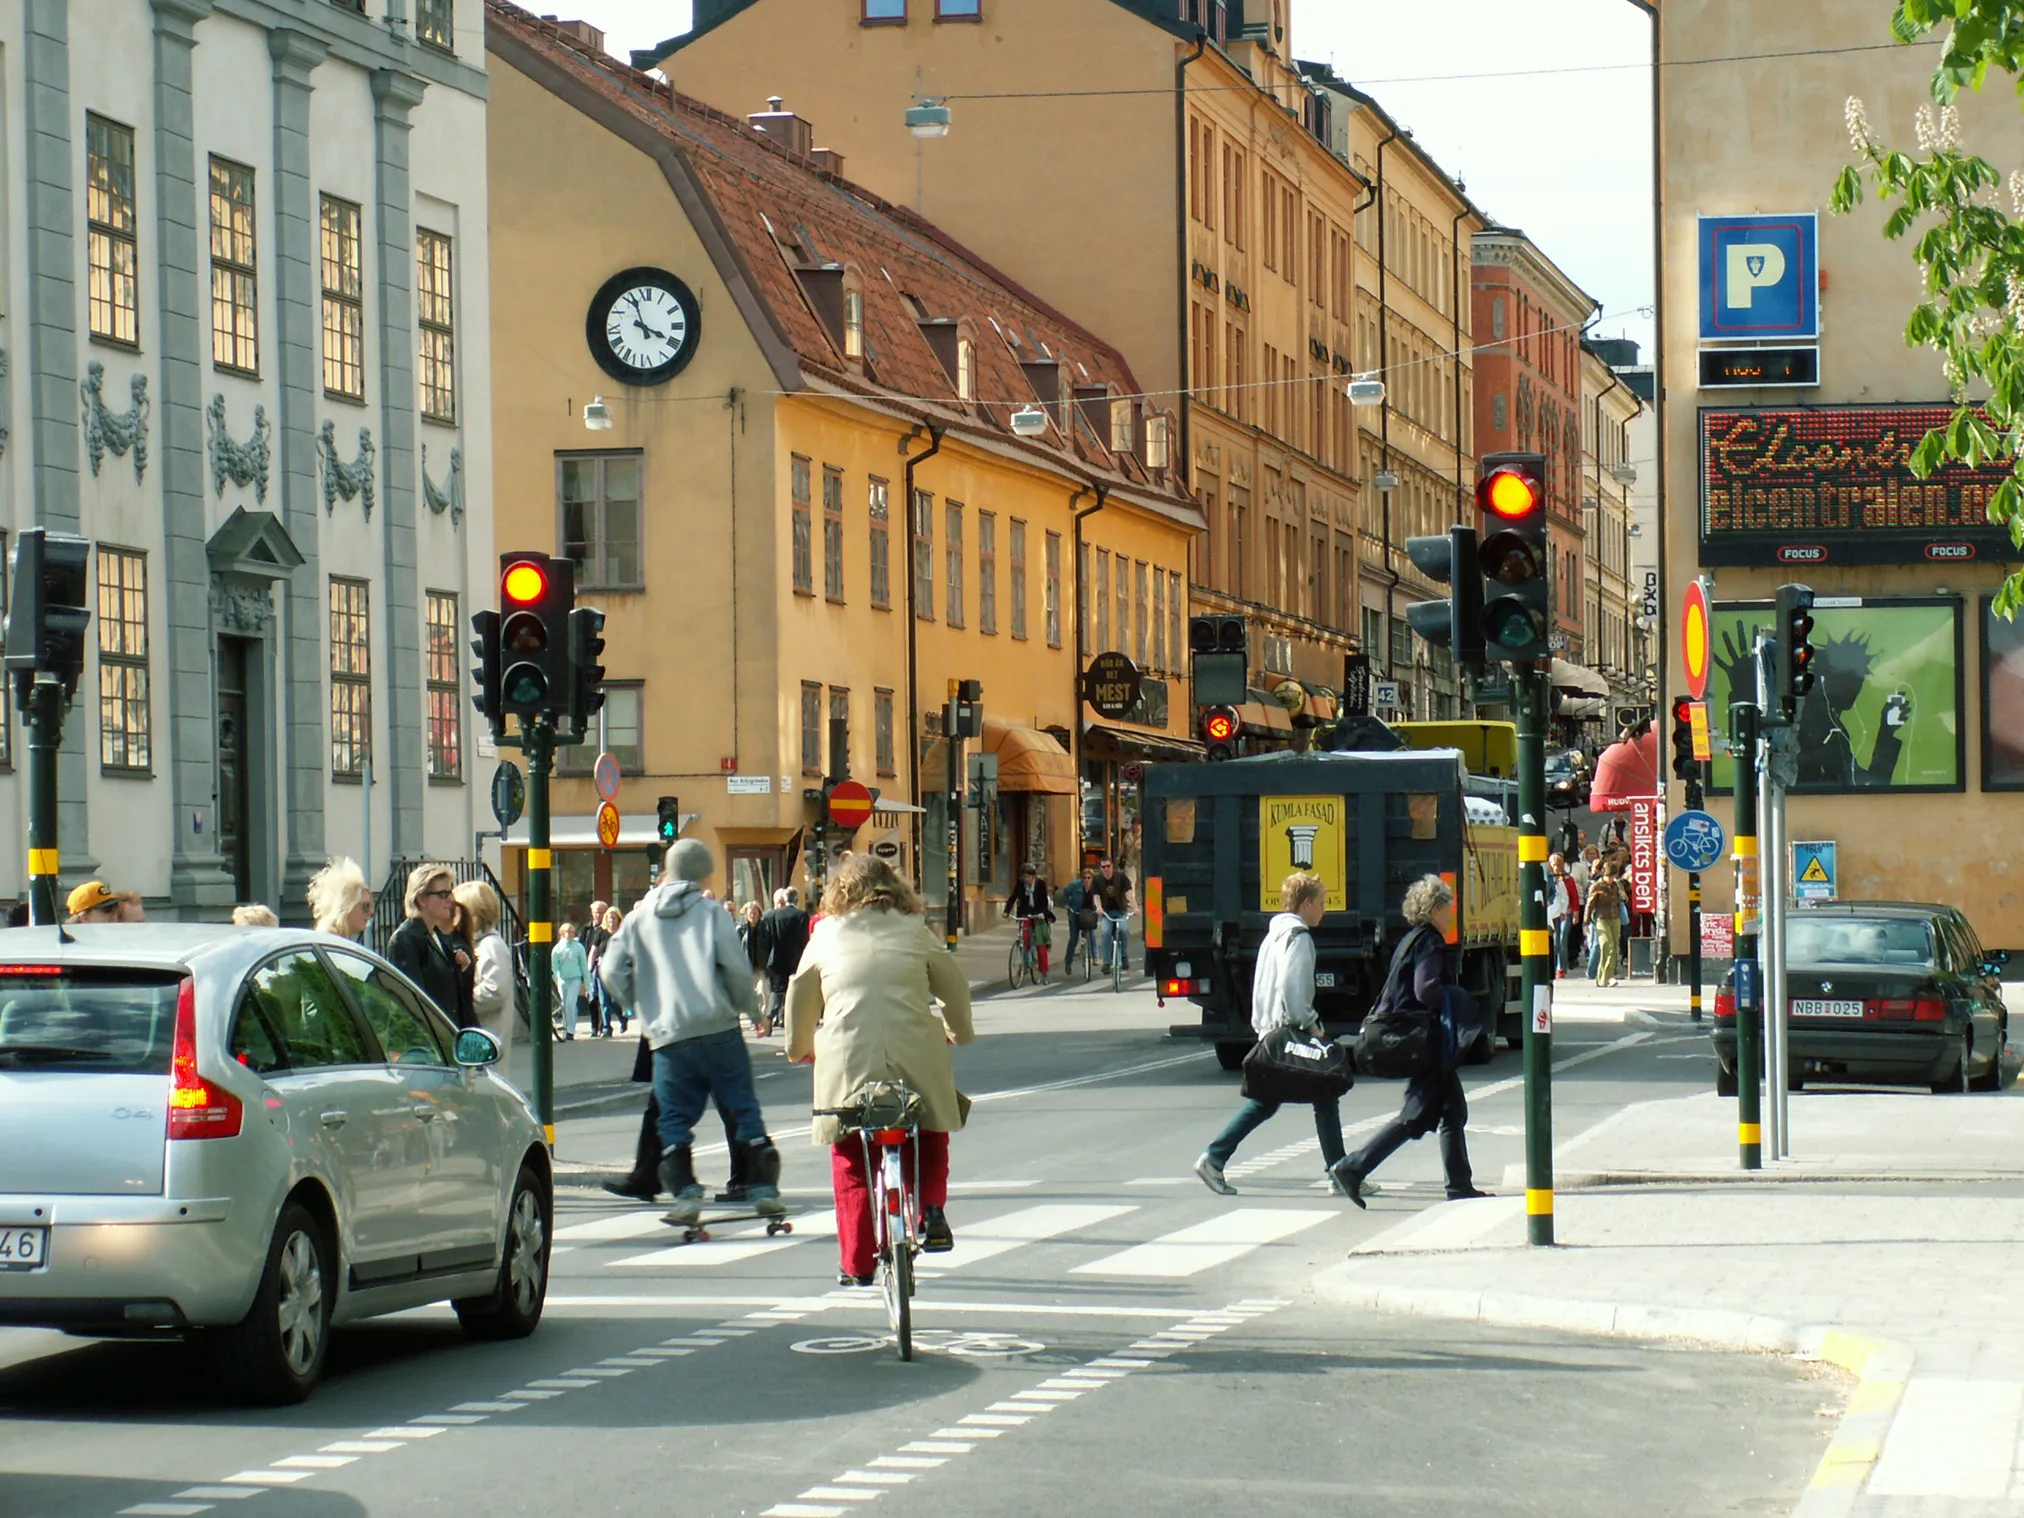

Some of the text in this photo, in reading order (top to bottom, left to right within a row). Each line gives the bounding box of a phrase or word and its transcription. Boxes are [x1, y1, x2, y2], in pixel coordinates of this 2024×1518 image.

[1726, 243, 1786, 309] P
[1785, 549, 1819, 558] FOCUS
[1932, 547, 1967, 556] FOCUS
[1095, 683, 1131, 702] MEST
[1378, 689, 1394, 702] 42
[1270, 802, 1335, 828] KUMLA FASAD
[1634, 802, 1654, 909] ansikts beh
[1796, 1002, 1860, 1015] NBB 025
[0, 1231, 34, 1258] 46
